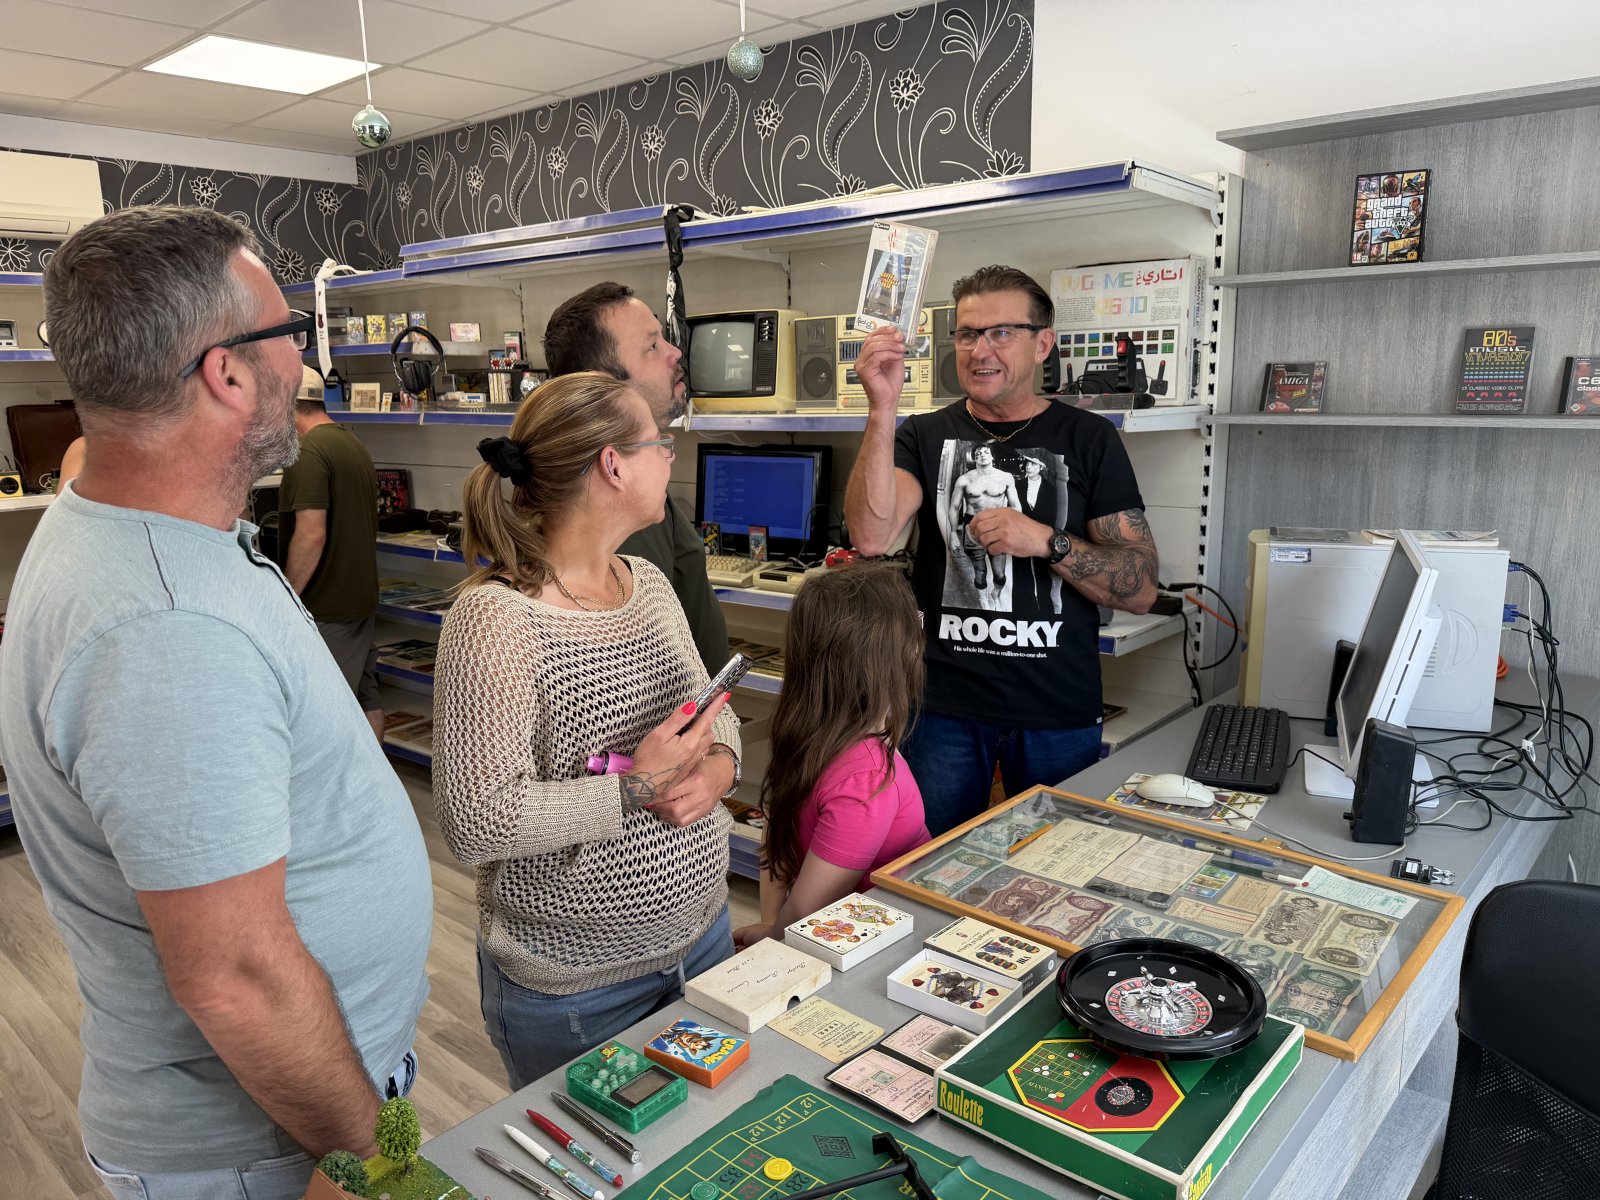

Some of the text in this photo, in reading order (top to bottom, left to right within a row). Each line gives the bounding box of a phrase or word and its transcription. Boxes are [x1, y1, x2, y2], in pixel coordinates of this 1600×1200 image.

[1373, 208, 1408, 218] theft
[1483, 330, 1518, 346] 80's
[938, 614, 1063, 648] ROCKY
[702, 1038, 737, 1066] CRASH
[940, 1080, 984, 1125] Roulette
[719, 1168, 743, 1186] 35
[785, 1172, 809, 1192] 28
[738, 1181, 762, 1200] 32
